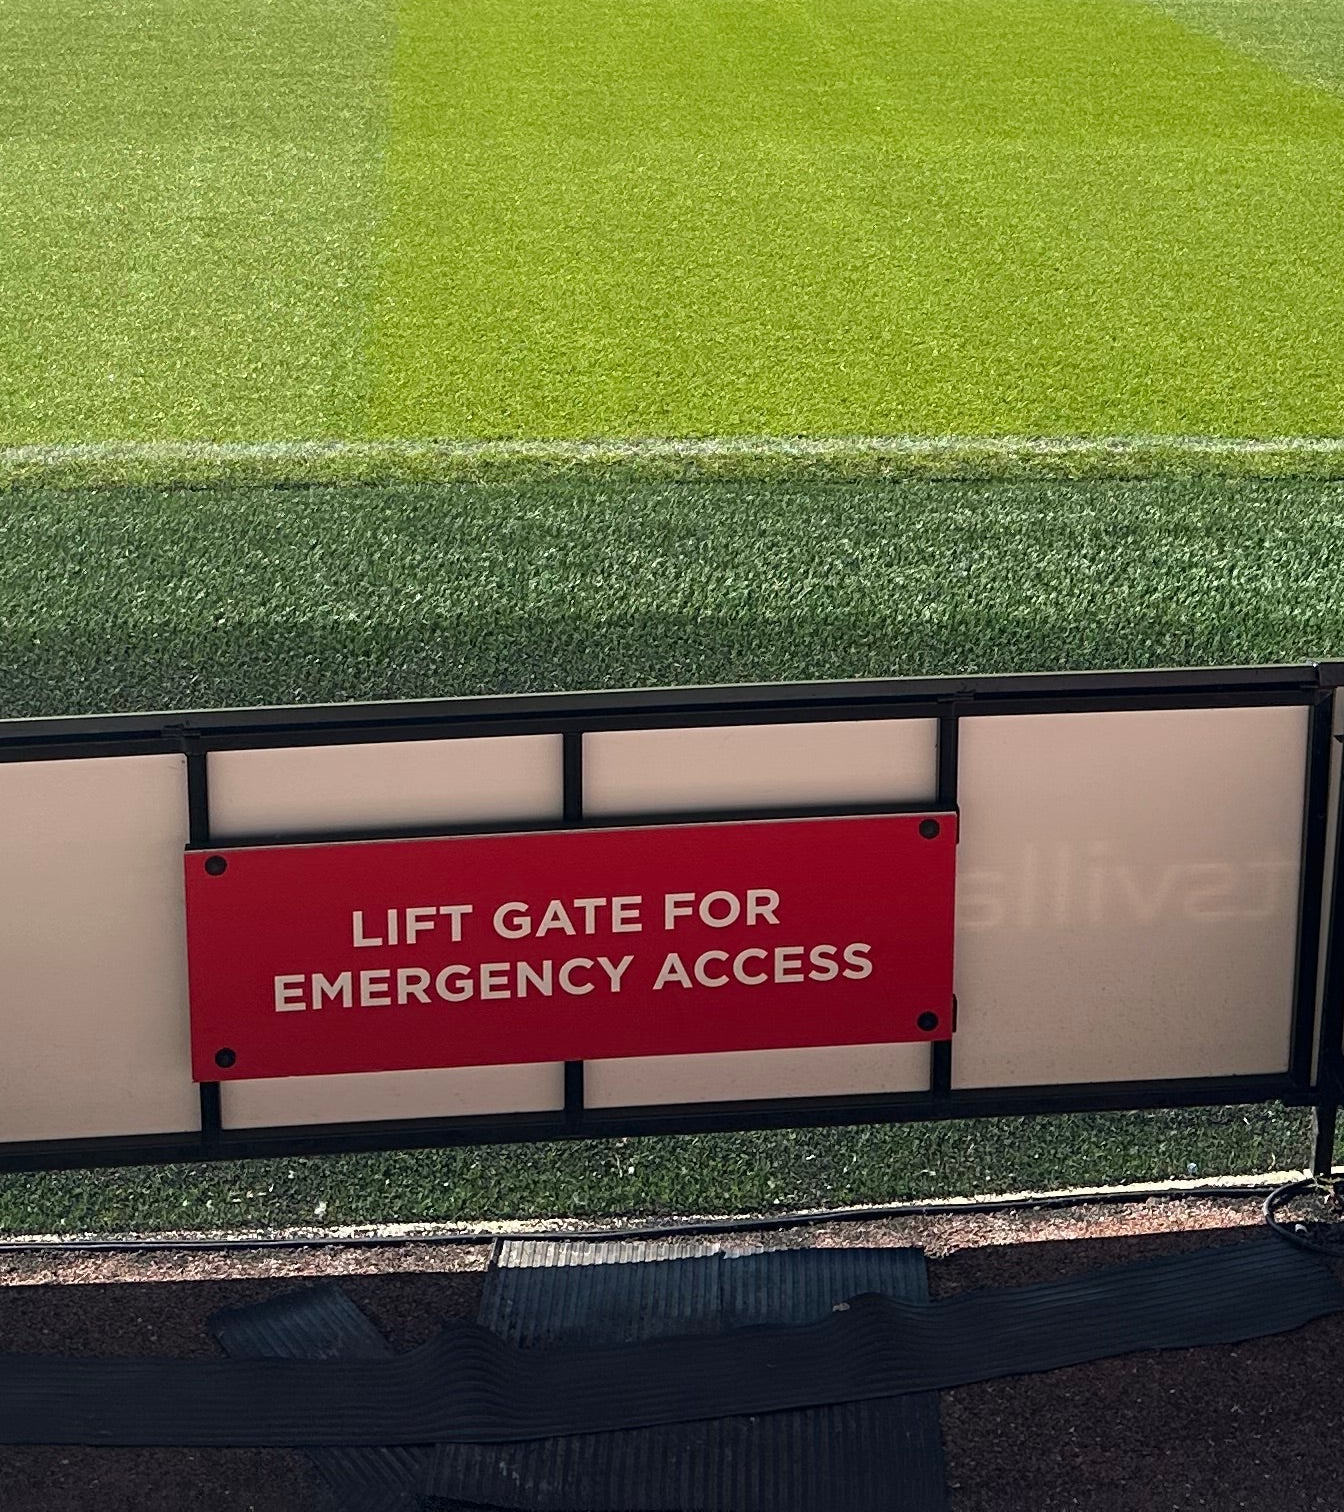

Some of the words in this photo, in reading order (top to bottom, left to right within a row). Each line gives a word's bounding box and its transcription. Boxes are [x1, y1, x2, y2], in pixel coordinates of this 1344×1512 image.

[351, 904, 473, 948] LIFT
[493, 895, 643, 940] GATE
[663, 888, 780, 931] FOR
[273, 955, 633, 1013] EMERGENCY
[653, 943, 873, 991] ACCESS
